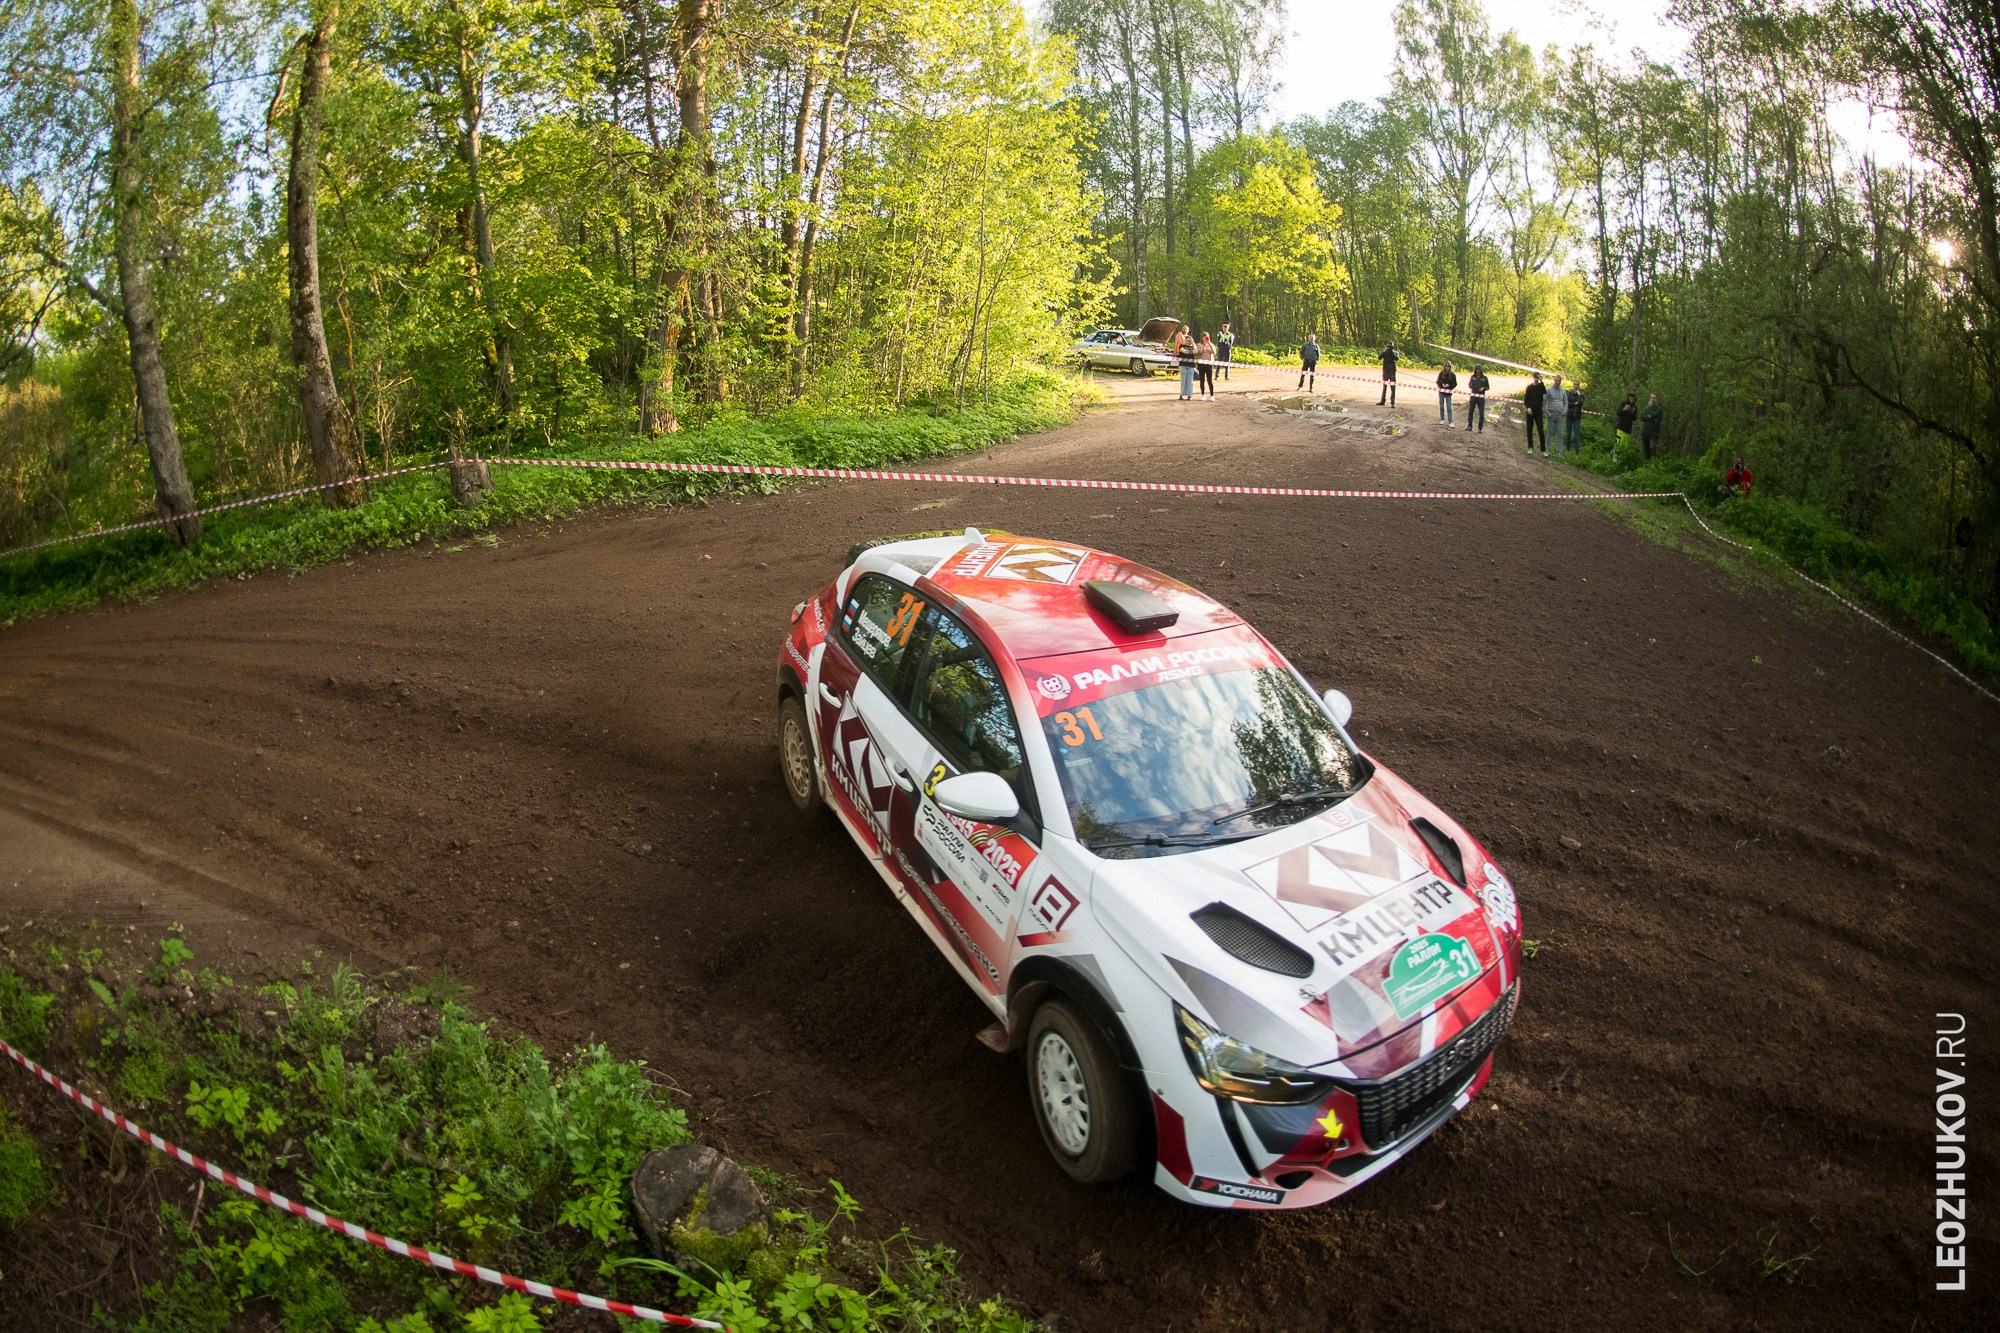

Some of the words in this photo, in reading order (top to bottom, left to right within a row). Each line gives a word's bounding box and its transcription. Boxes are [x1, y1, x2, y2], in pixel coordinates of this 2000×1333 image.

[886, 592, 925, 646] 31
[852, 627, 876, 658] Зайцев
[1073, 657, 1165, 690] РАЛЛИ
[1055, 707, 1104, 746] 31
[925, 765, 946, 796] 3
[982, 838, 1022, 887] 2025
[1449, 943, 1479, 978] 31
[1218, 1183, 1278, 1202] YOKOHAMA
